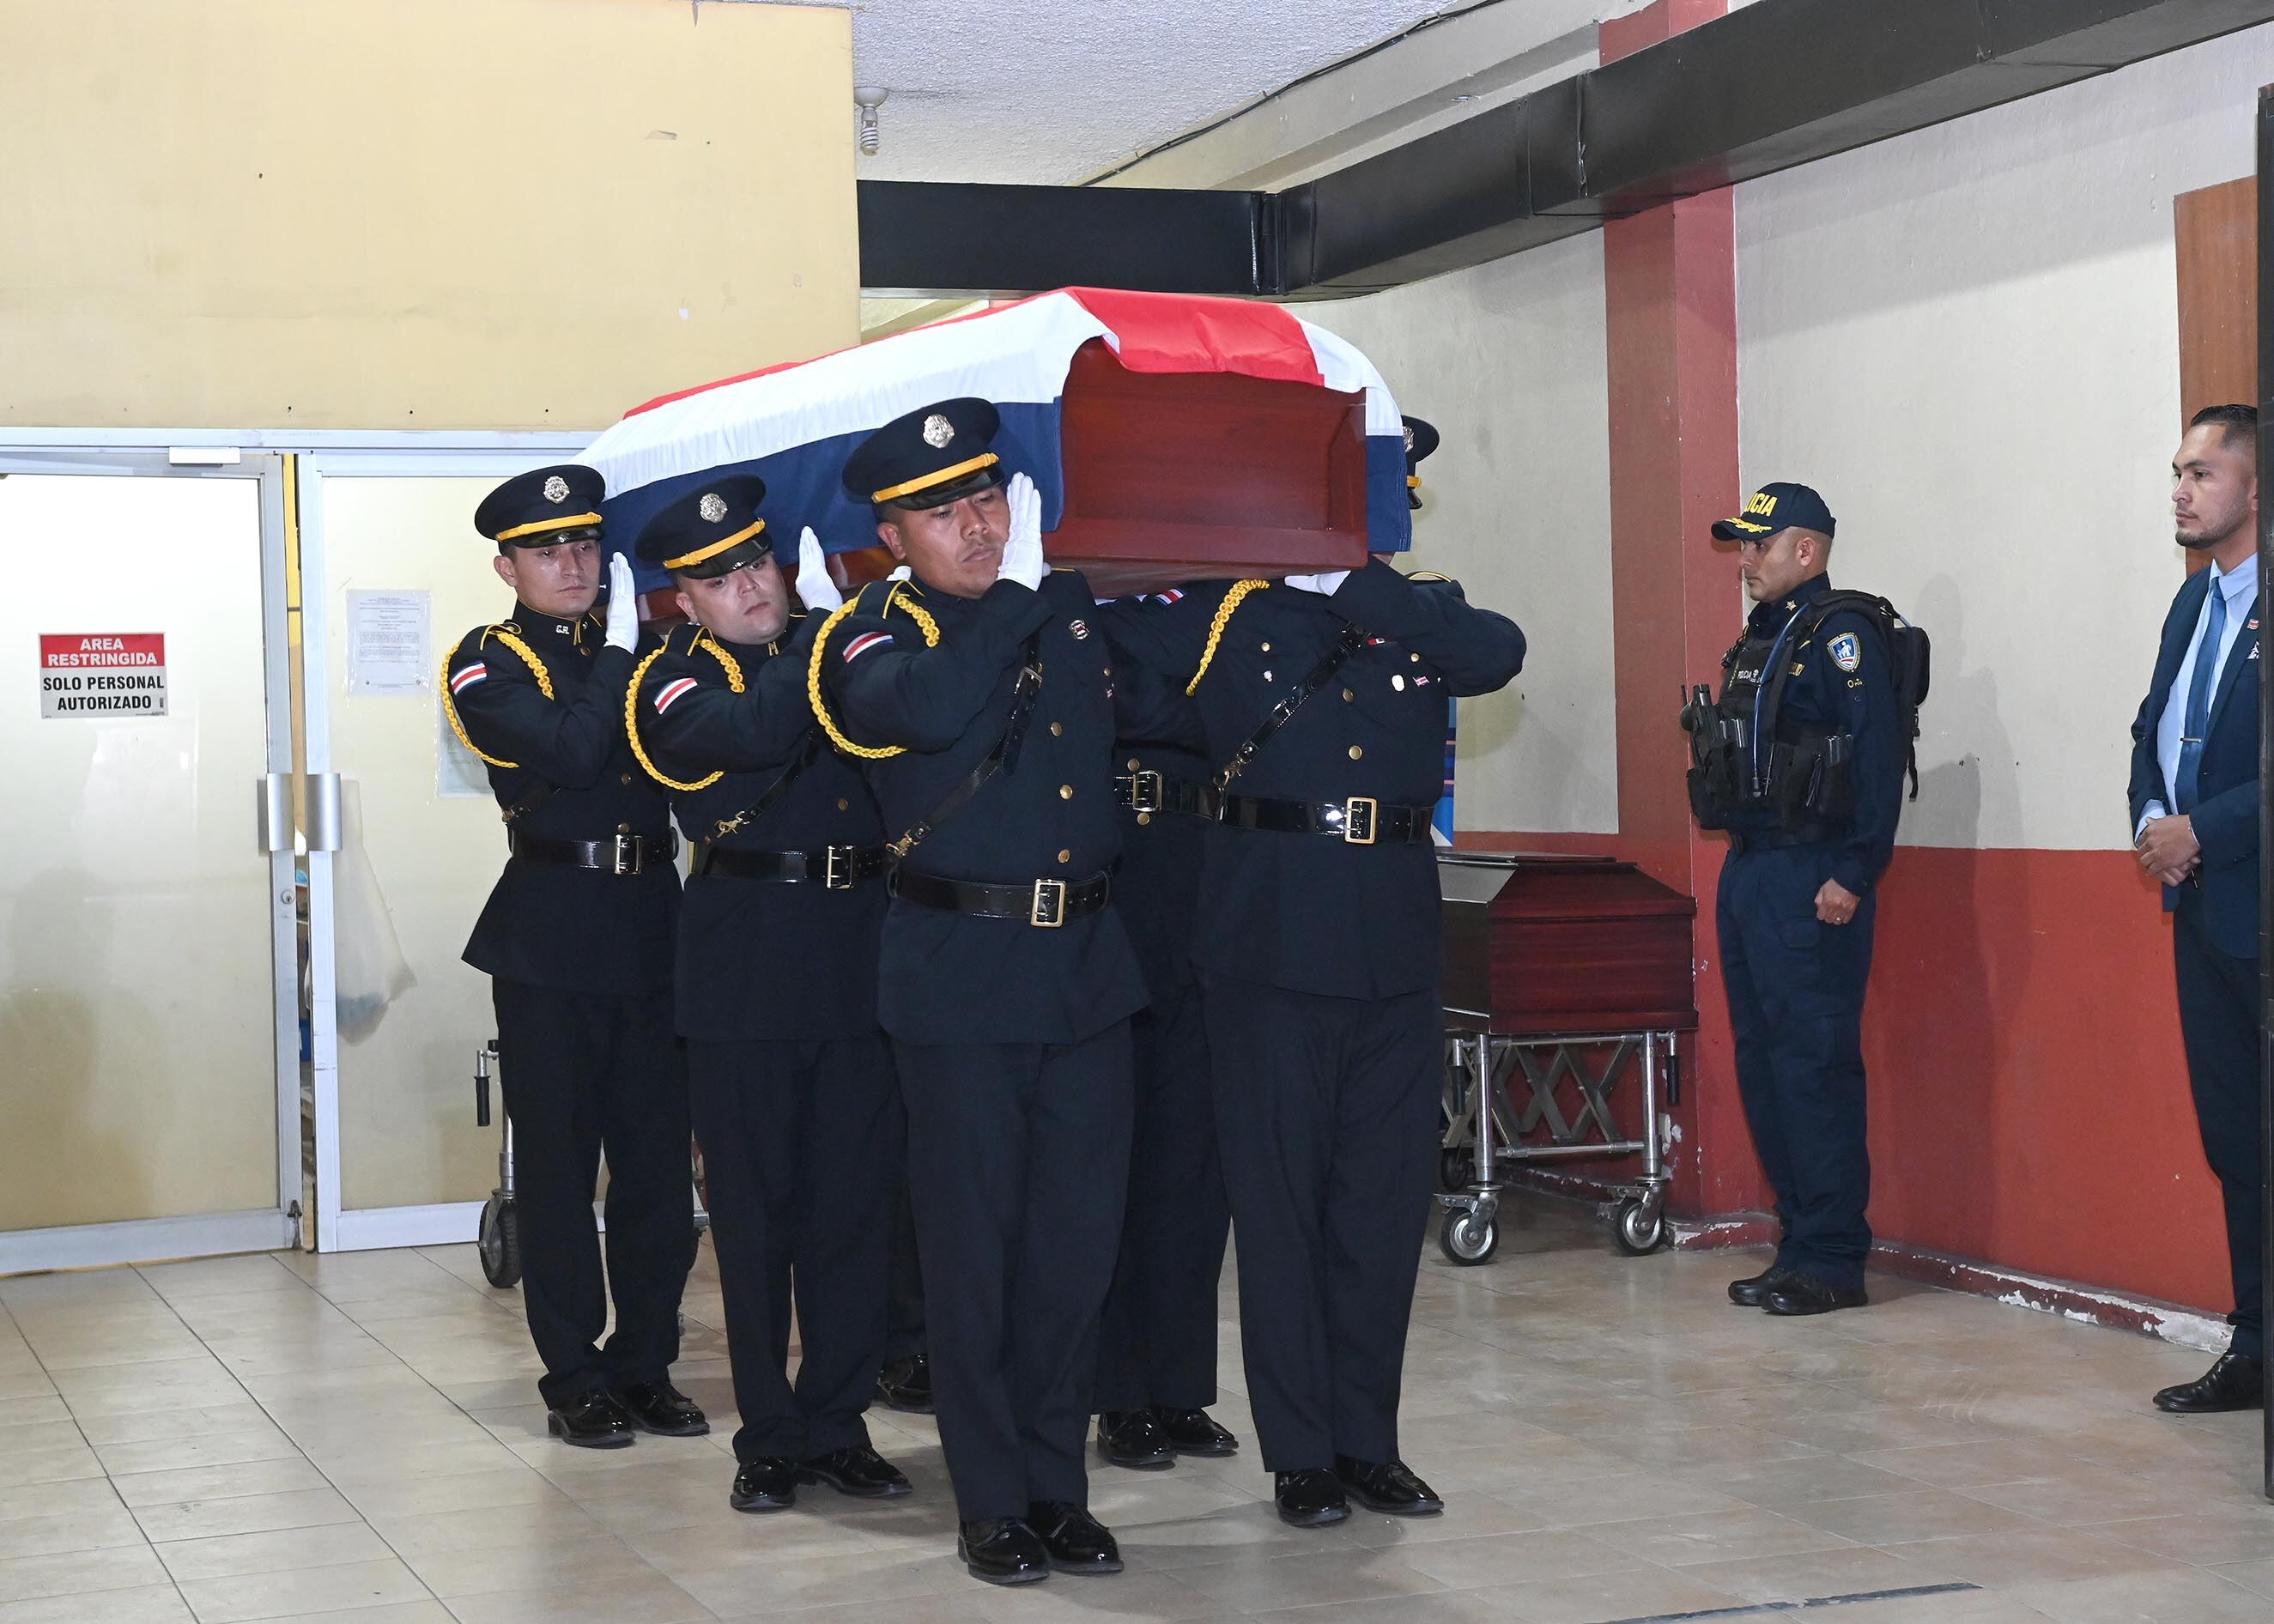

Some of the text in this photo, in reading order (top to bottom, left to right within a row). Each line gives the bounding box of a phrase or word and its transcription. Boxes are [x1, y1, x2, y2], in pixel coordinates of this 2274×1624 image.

[1743, 493, 1778, 517] ICIA
[80, 638, 124, 651] AREA
[47, 652, 157, 666] RESTRINGIDA
[43, 676, 164, 691] SOLO PERSONAL
[58, 695, 152, 710] AUTORIZADO
